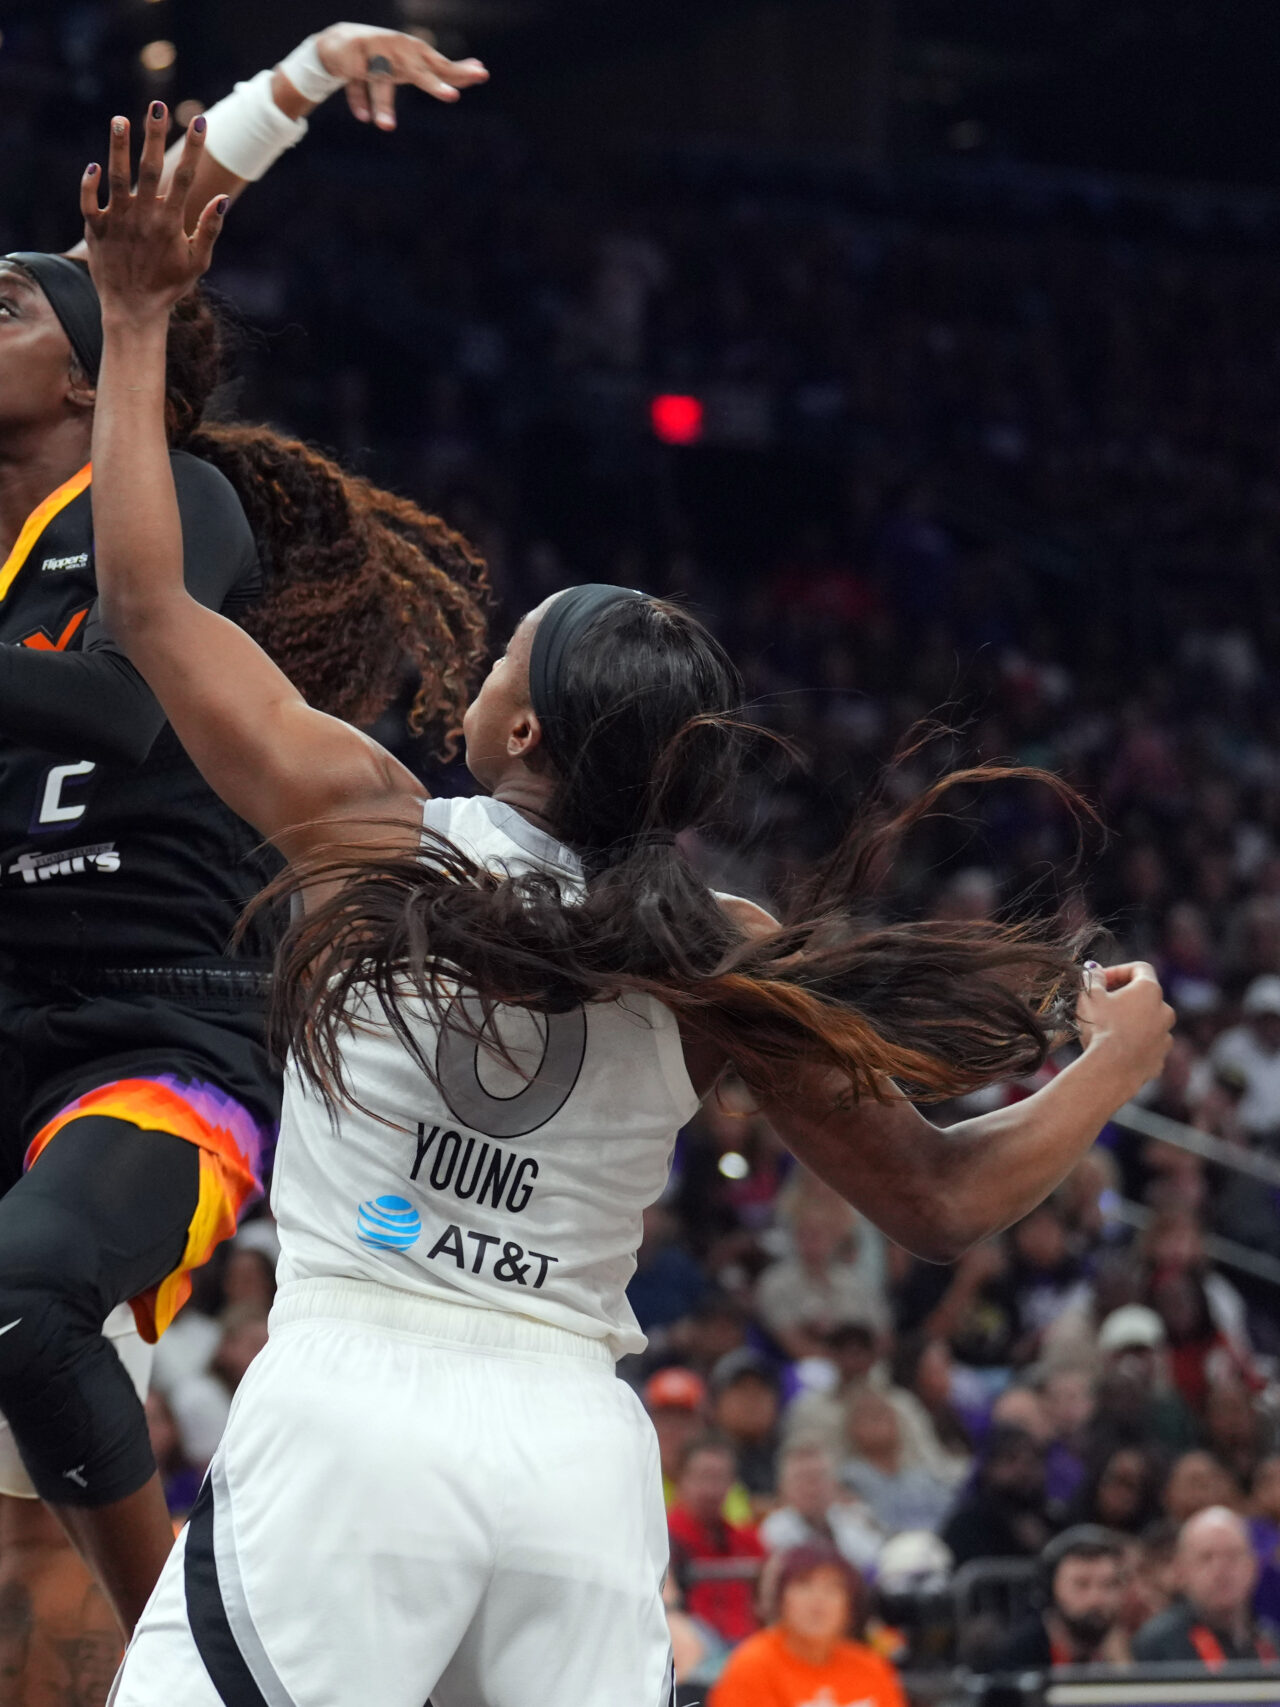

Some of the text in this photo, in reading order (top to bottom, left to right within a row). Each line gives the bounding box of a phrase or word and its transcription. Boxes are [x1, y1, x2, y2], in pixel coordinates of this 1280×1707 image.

[435, 985, 588, 1140] 0
[409, 1121, 540, 1214] YOUNG
[426, 1224, 559, 1289] AT&T
